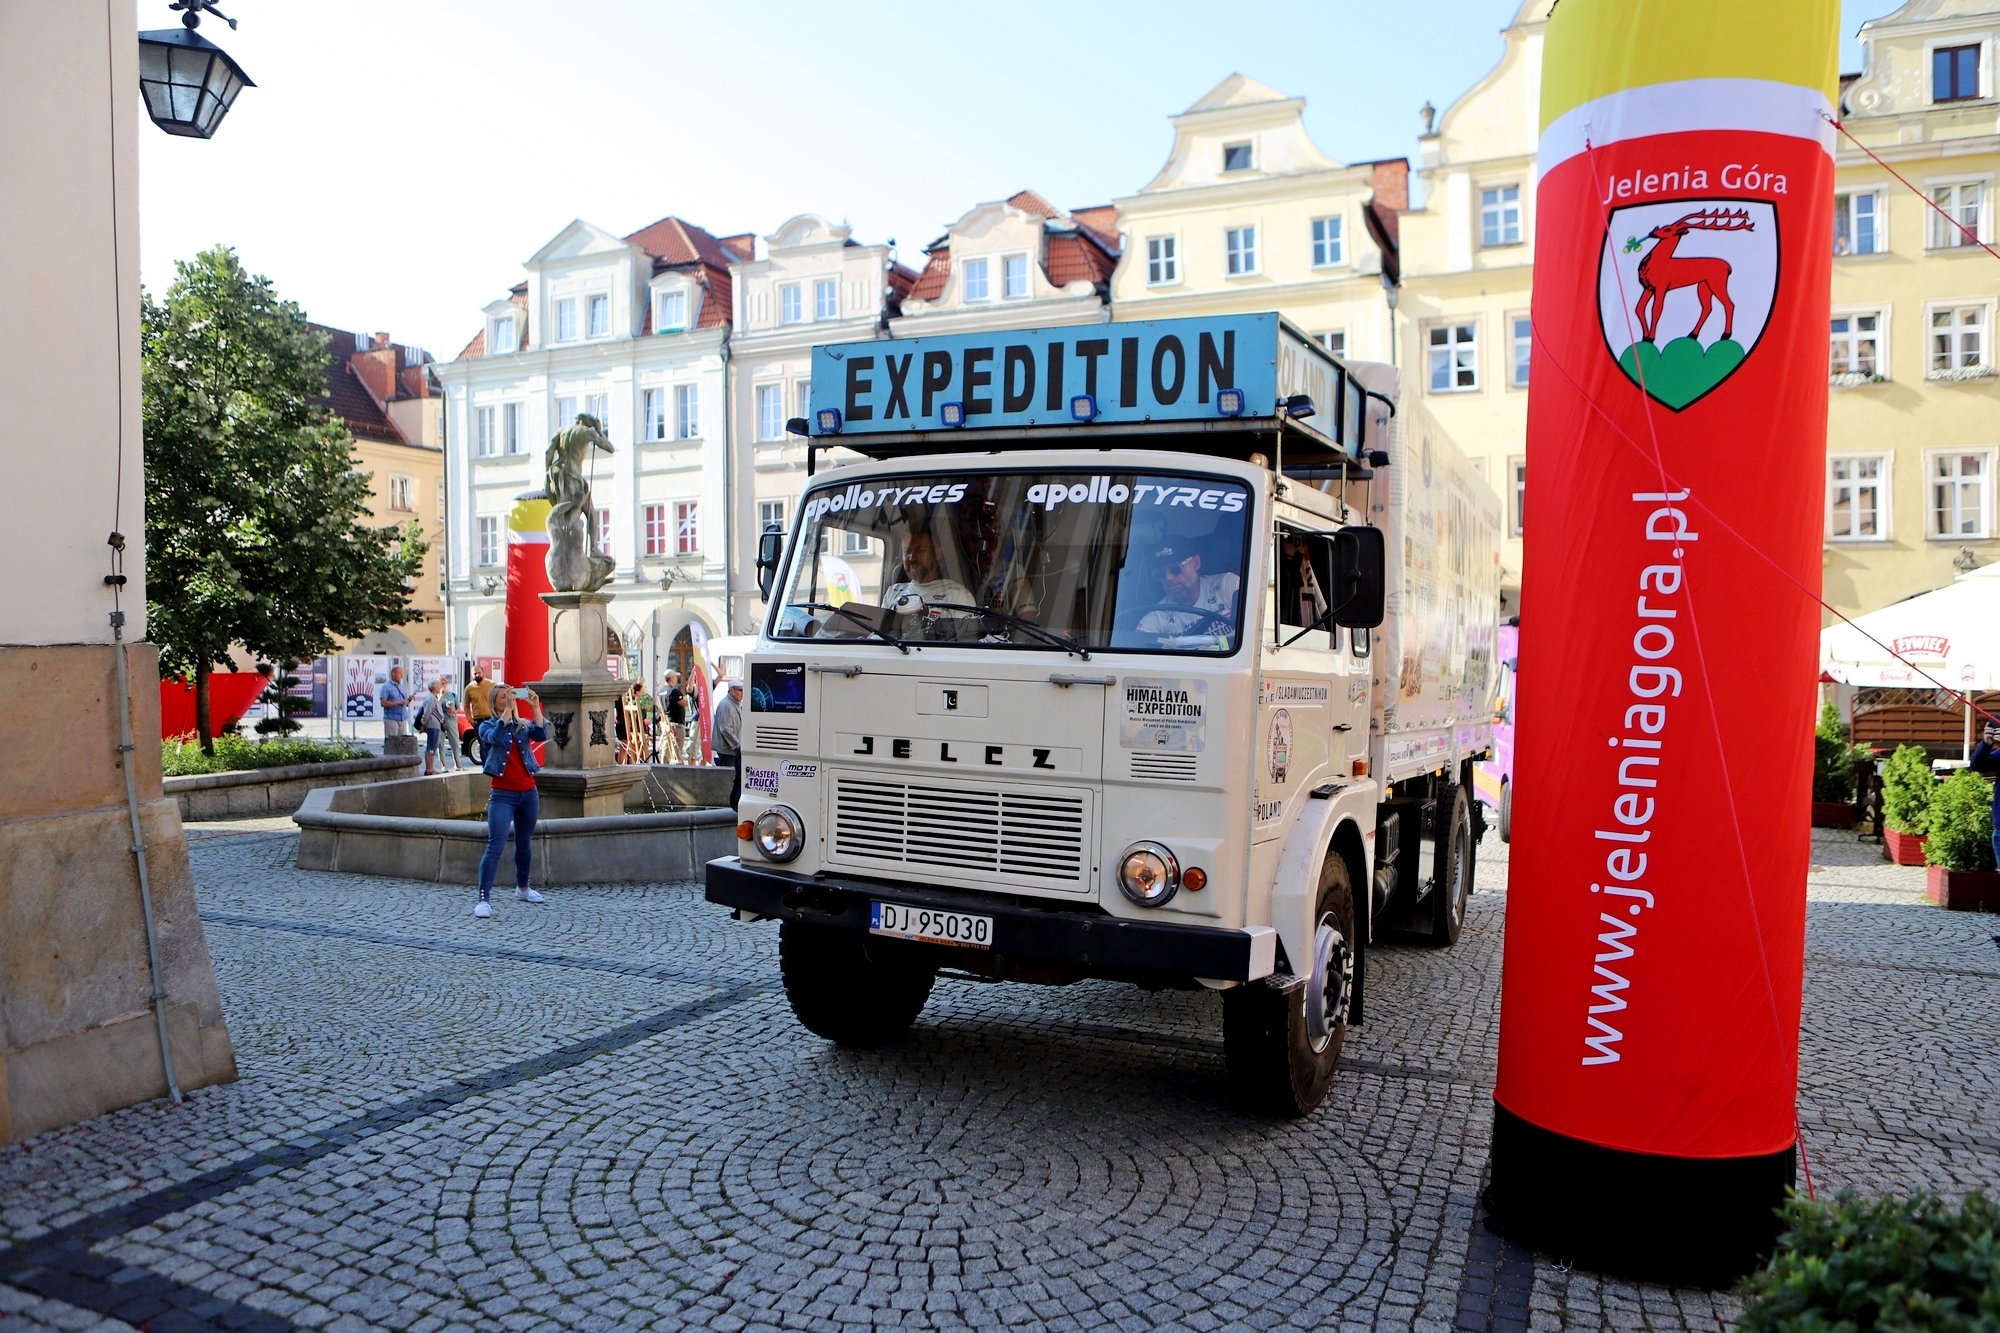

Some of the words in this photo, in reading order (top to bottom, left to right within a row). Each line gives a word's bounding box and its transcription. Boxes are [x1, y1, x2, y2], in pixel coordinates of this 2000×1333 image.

[1603, 165, 1709, 206] Jelenia
[1720, 163, 1788, 195] Góra
[845, 330, 1236, 421] EXPEDITION
[805, 484, 875, 522] apollo
[875, 483, 969, 507] TYRES
[1027, 475, 1130, 511] apollo
[1131, 484, 1248, 512] TYRES
[1126, 688, 1188, 703] HIMALAYA
[1137, 702, 1201, 716] EXPEDITION
[854, 736, 1055, 769] JELCZ
[749, 770, 776, 779] MASTER
[749, 778, 775, 788] TRUCK
[1581, 487, 1699, 1066] www.jeleniagora.pl
[1258, 801, 1281, 822] POLAND
[884, 905, 909, 931] DJ
[919, 911, 988, 942] 95030
